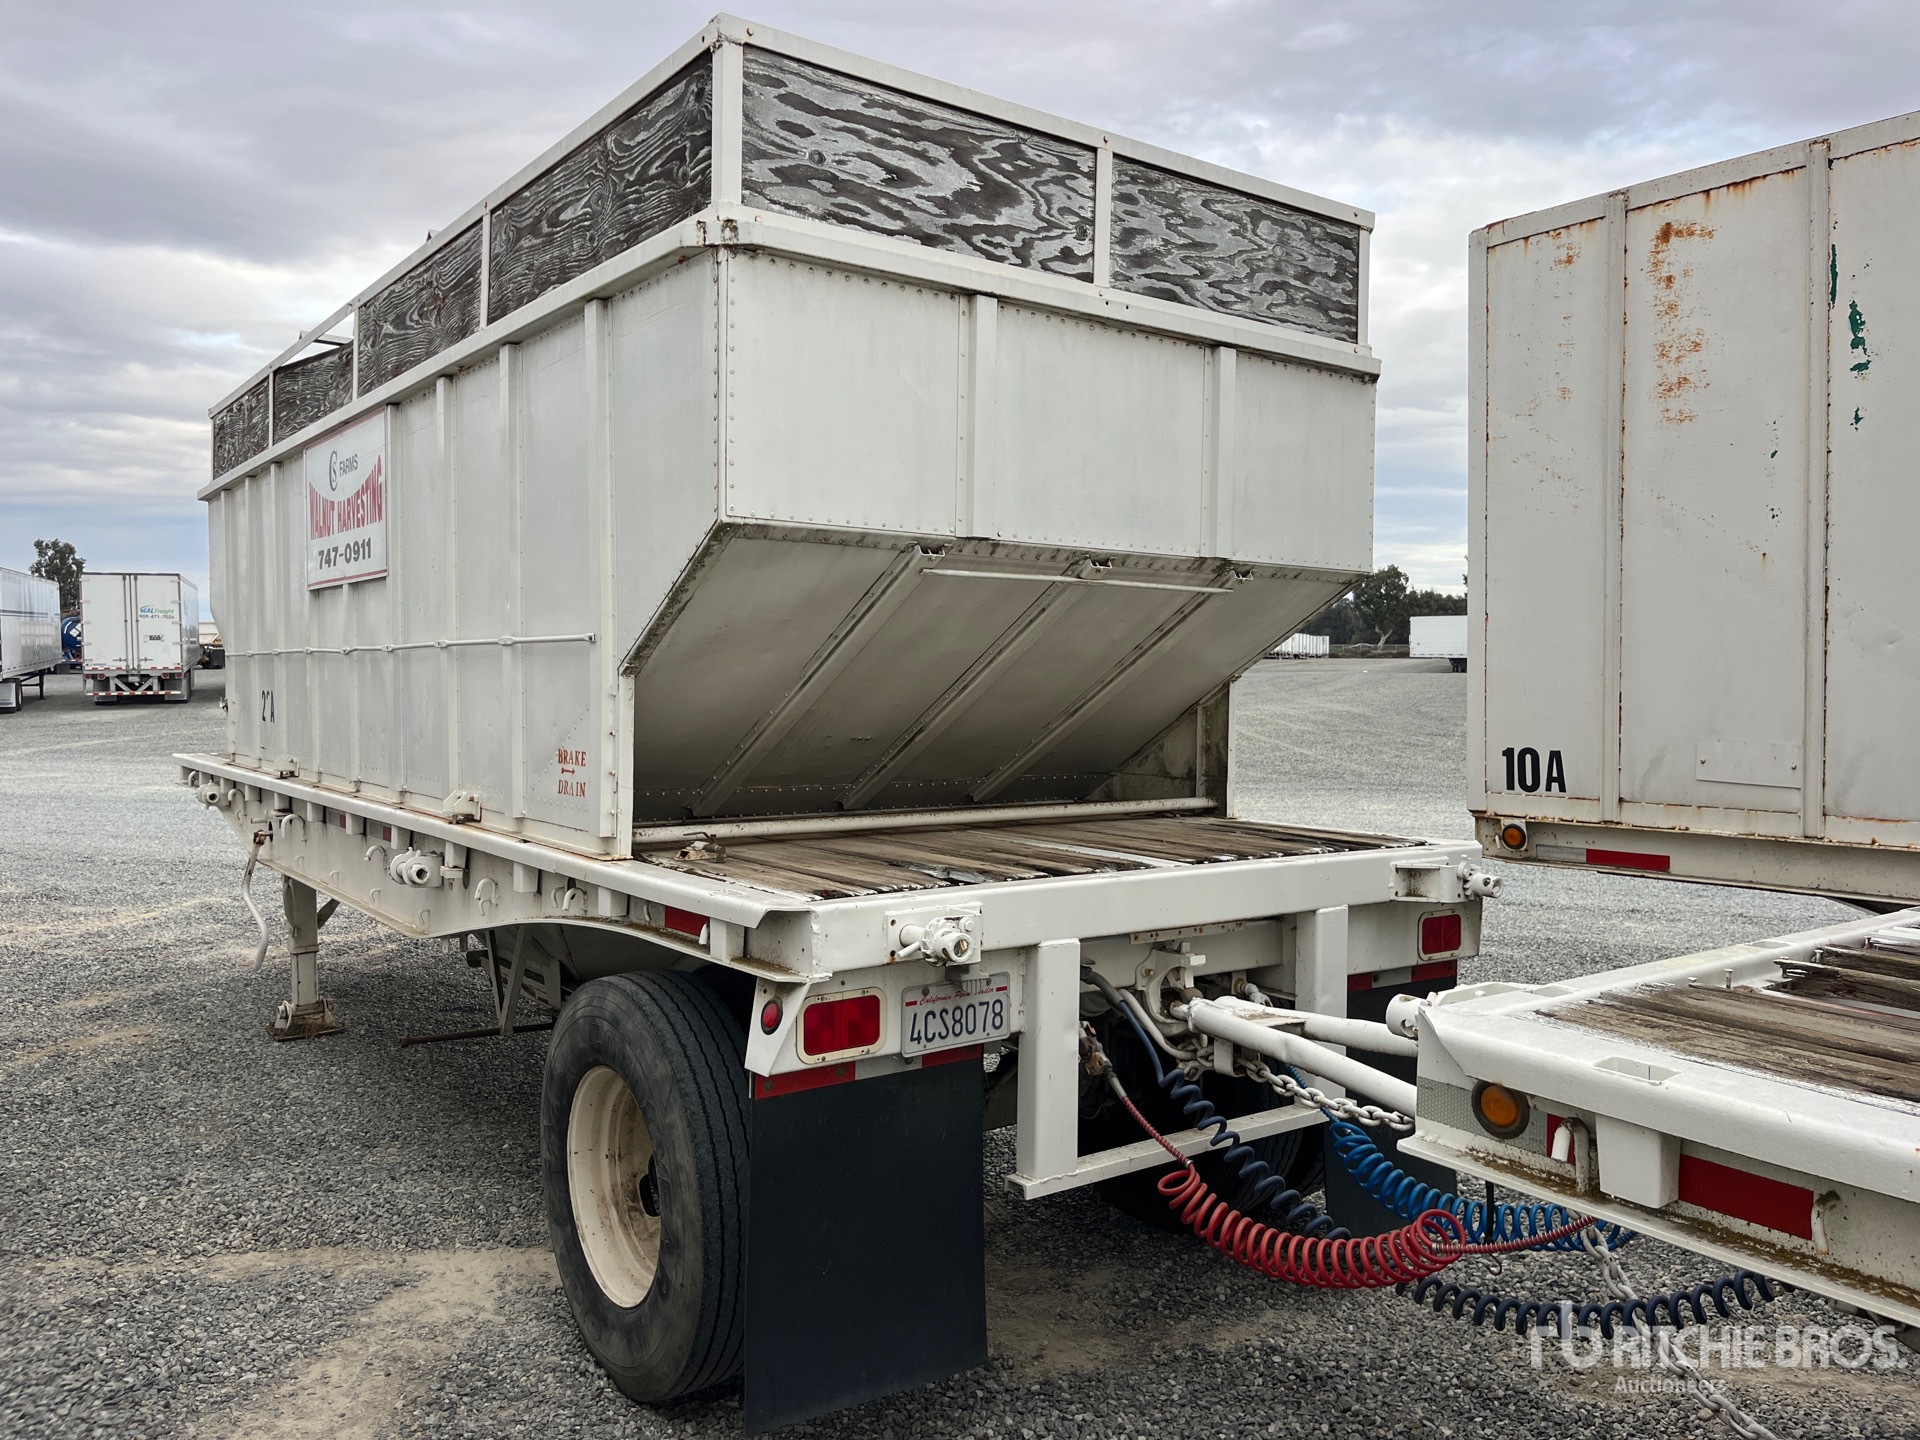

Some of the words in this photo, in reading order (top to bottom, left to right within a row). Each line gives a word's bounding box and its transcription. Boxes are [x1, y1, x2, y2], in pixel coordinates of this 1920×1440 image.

[339, 453, 359, 478] FARMS
[308, 480, 336, 541] WALNUT
[337, 454, 383, 534] HARVESTING
[318, 537, 372, 570] 747-0911
[557, 748, 587, 767] BRAKE
[1501, 747, 1567, 793] 10A
[557, 779, 586, 798] DRAIN
[919, 994, 952, 1006] California
[975, 987, 994, 996] railer
[909, 998, 1004, 1045] 4CS8078
